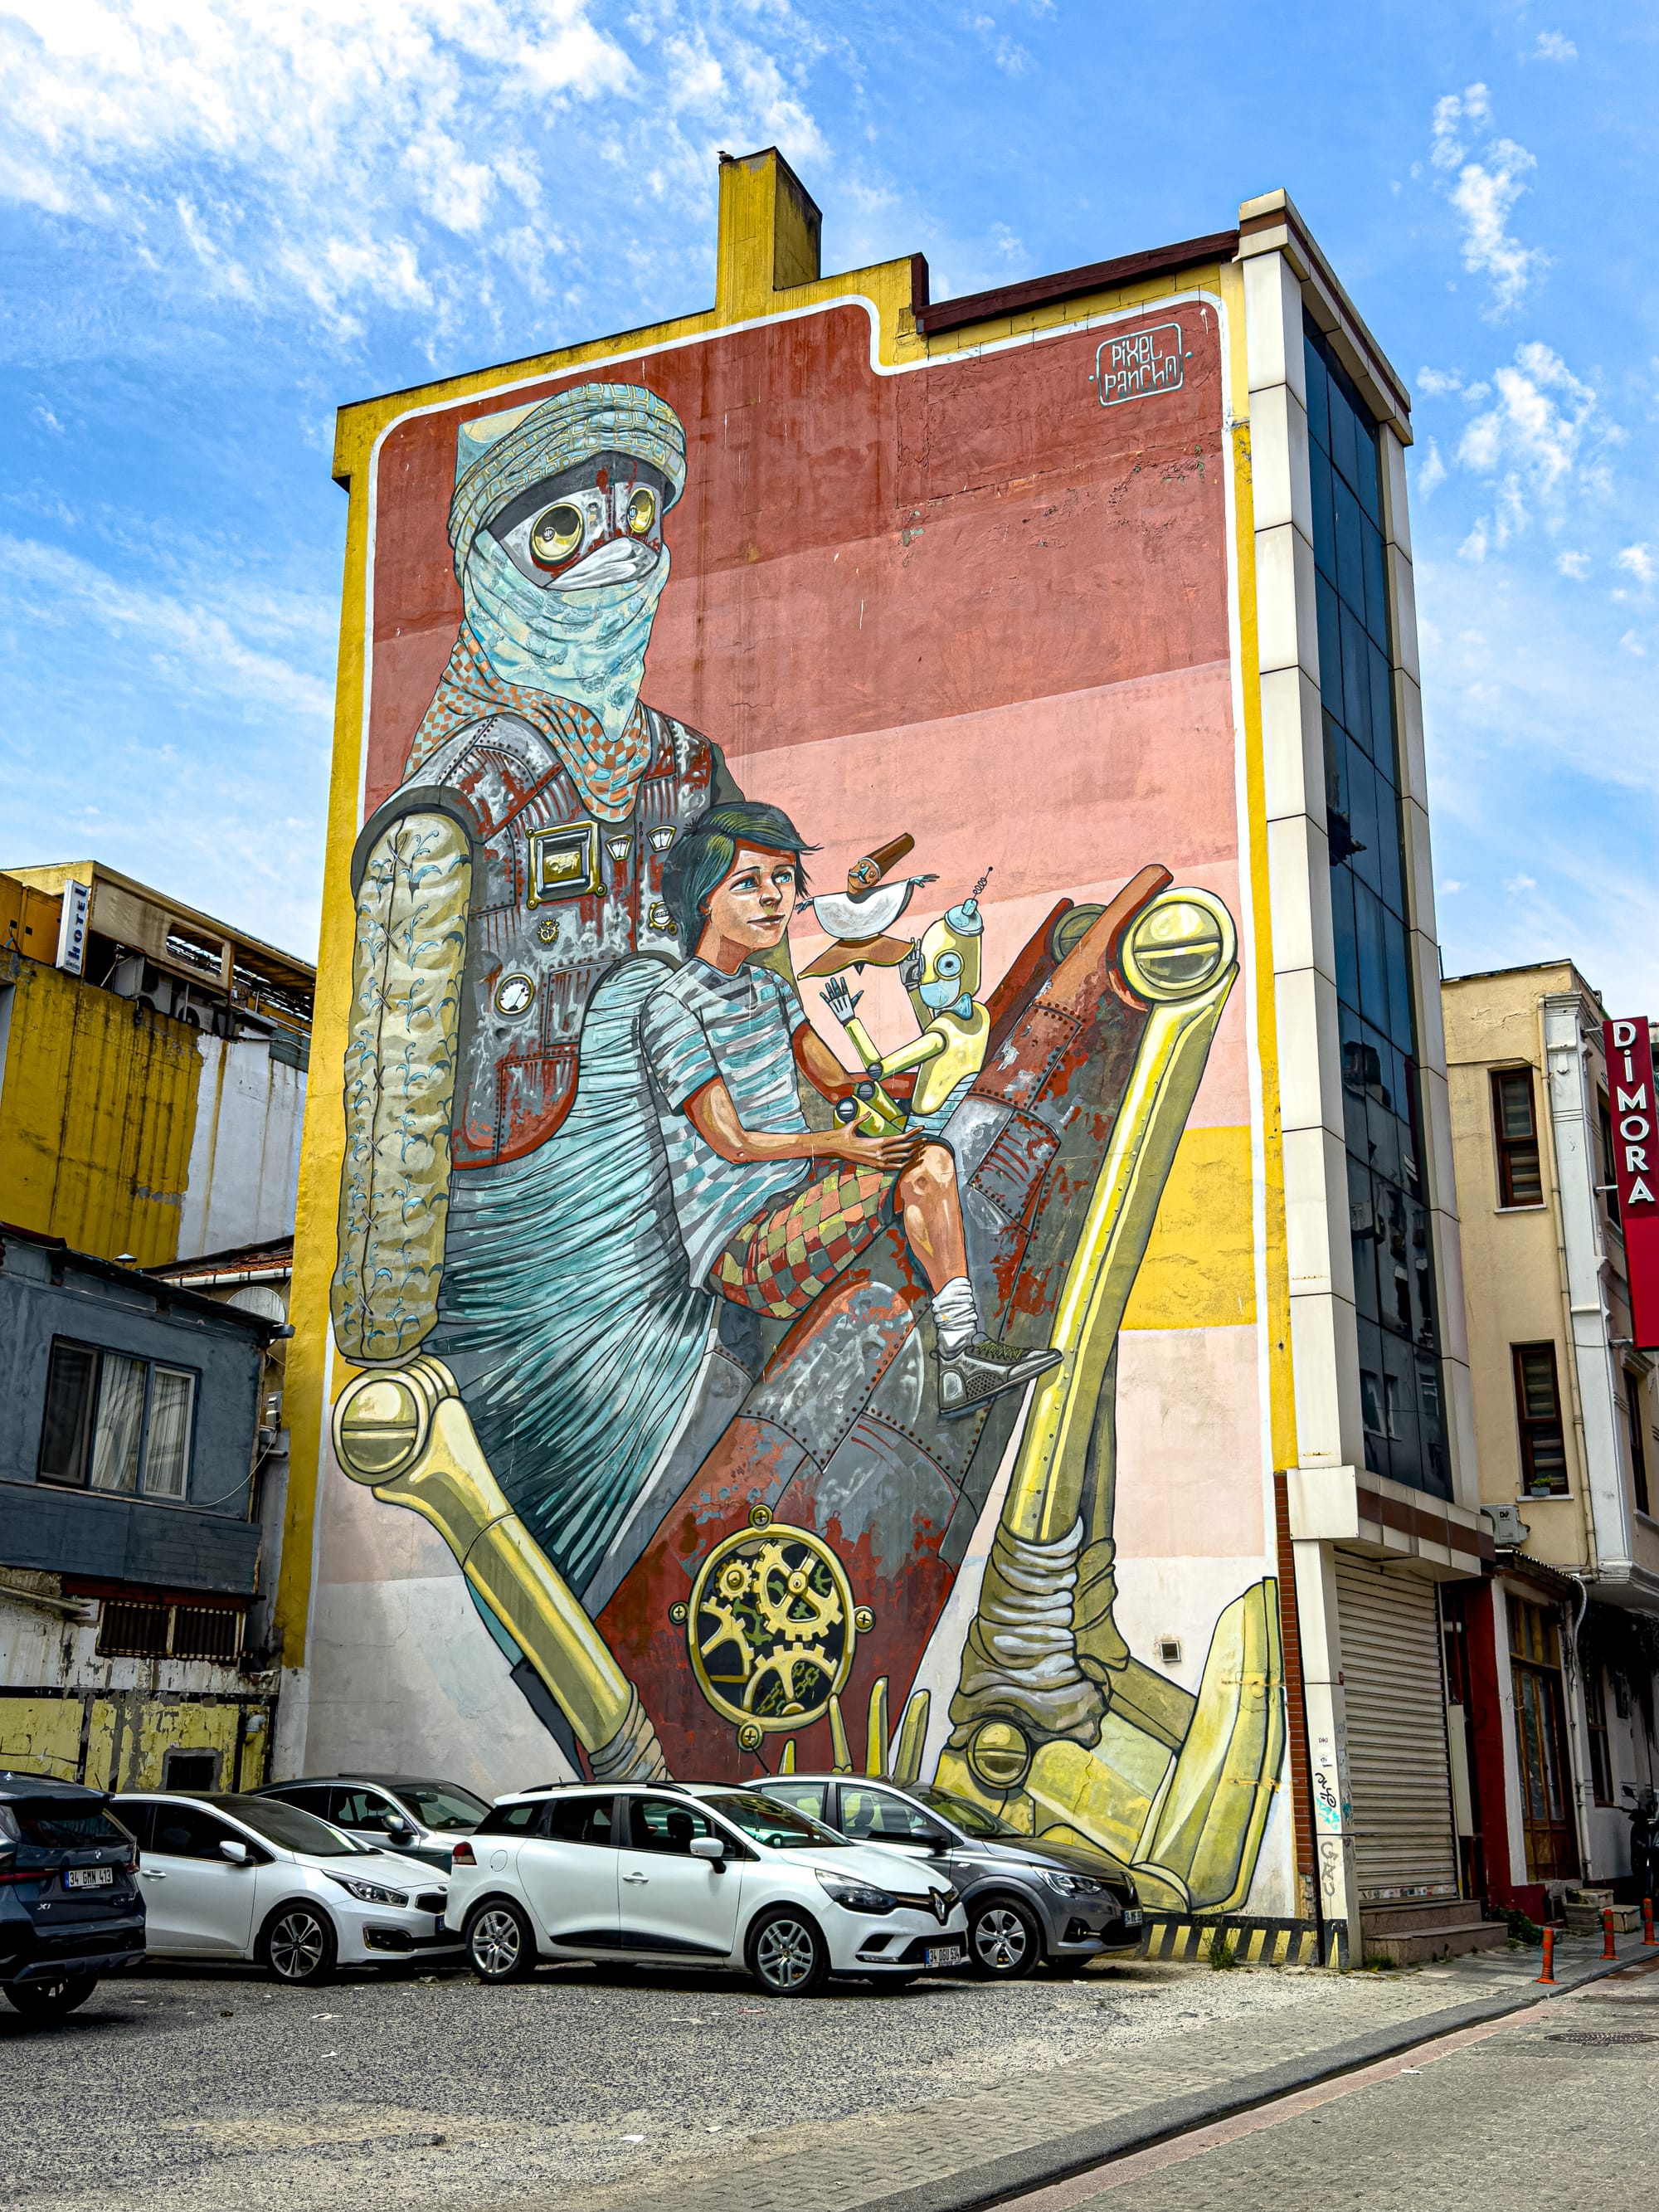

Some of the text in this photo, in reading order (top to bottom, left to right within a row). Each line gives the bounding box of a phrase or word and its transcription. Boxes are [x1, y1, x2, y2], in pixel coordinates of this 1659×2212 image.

[67, 887, 87, 961] HOTEL
[70, 1872, 79, 1885] 34
[99, 1869, 111, 1883] 413
